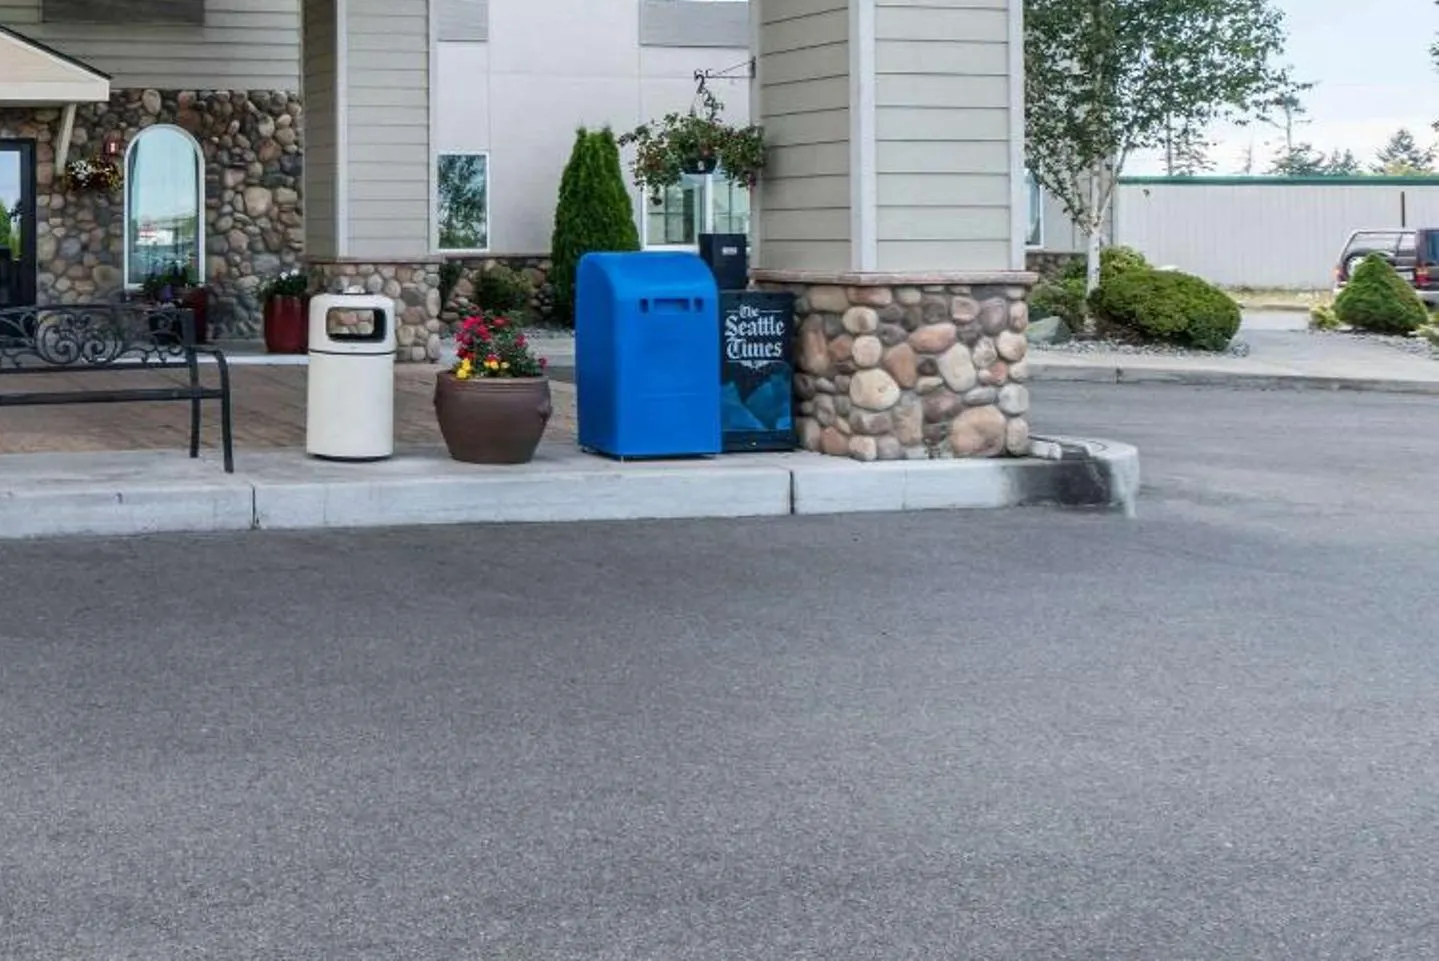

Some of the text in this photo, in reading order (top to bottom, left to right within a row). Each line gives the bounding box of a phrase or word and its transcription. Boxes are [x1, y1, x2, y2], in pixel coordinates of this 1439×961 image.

[739, 304, 759, 318] The
[725, 315, 785, 336] Seattle
[726, 337, 782, 359] Times
